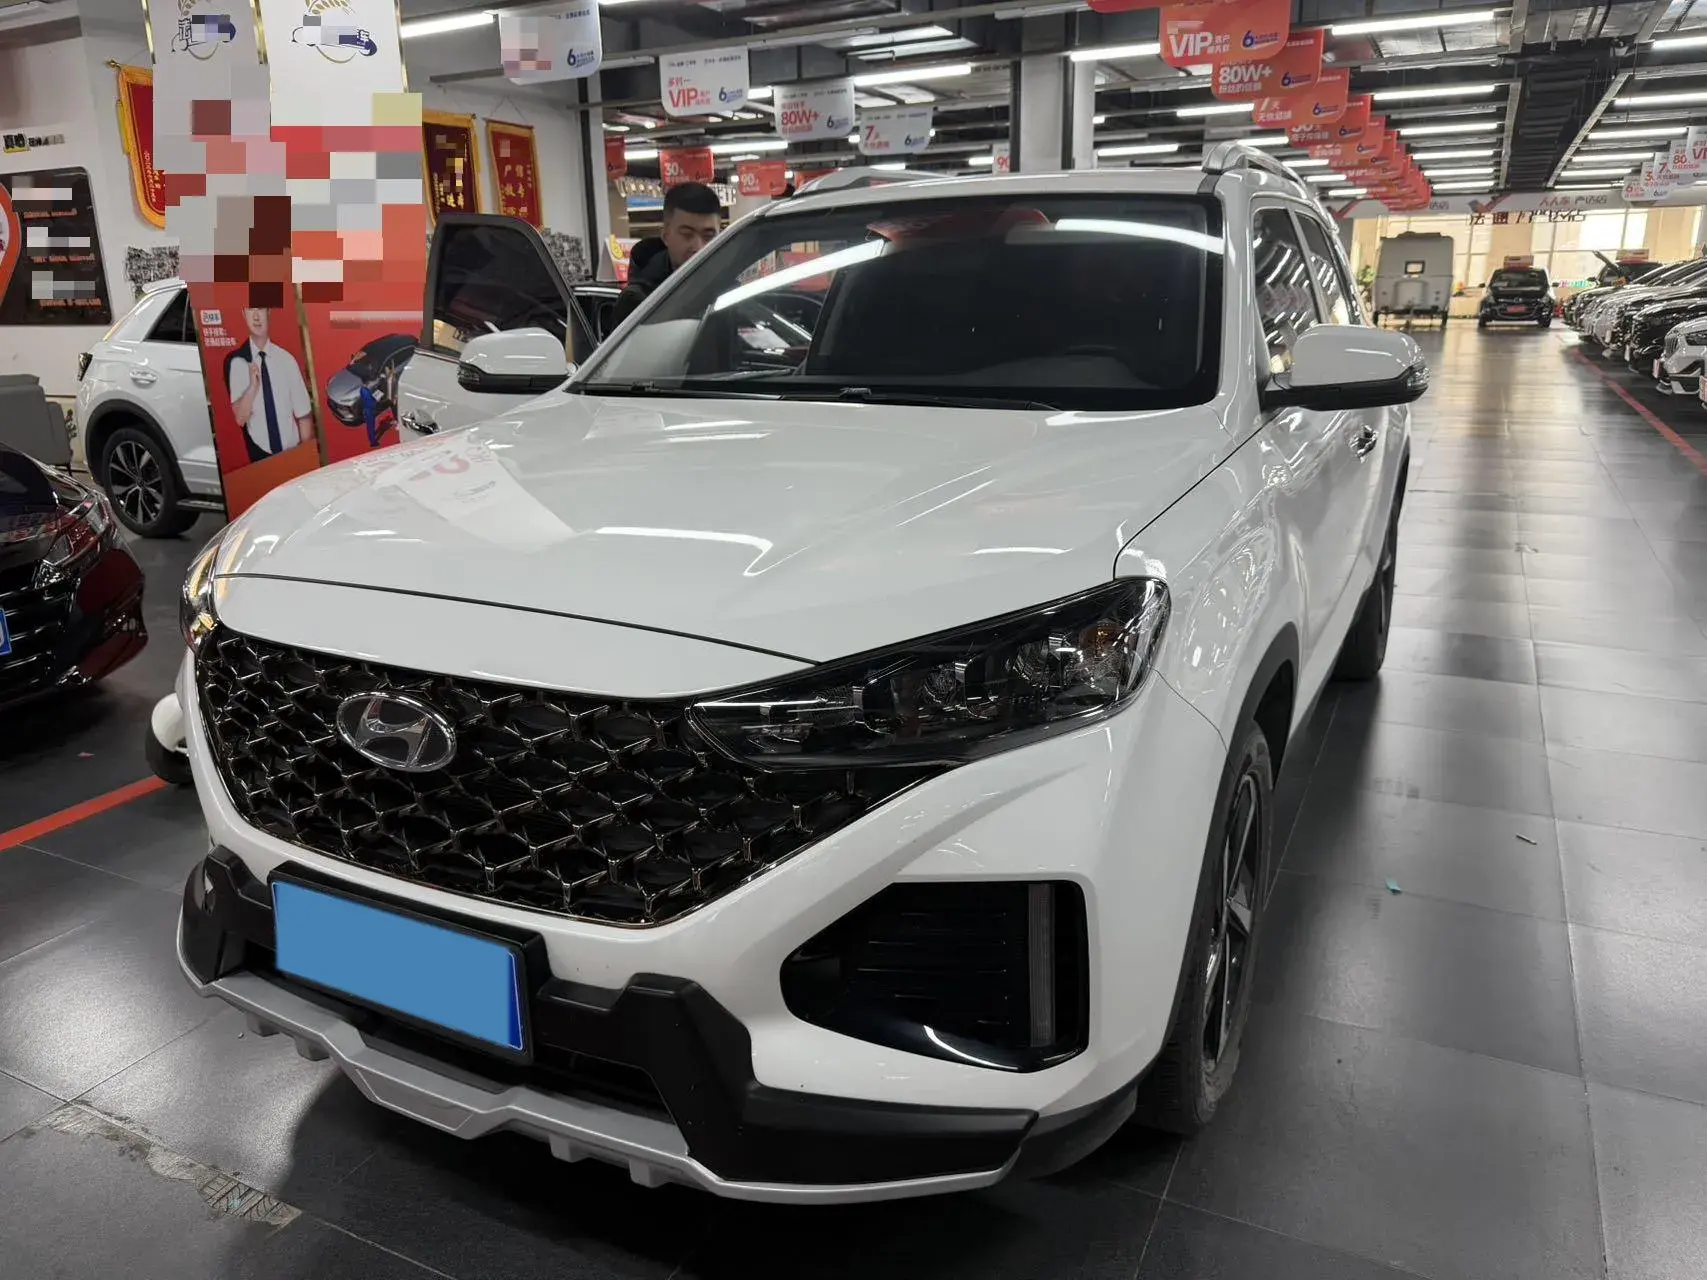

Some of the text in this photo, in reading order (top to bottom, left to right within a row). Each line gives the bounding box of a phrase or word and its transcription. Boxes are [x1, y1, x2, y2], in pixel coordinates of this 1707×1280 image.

[1168, 31, 1214, 58] VIP
[1243, 30, 1254, 48] 6
[567, 48, 576, 66] 6
[1218, 64, 1273, 83] 80W+
[1281, 71, 1292, 86] 6
[668, 87, 698, 108] VIP
[718, 86, 728, 101] 6
[1313, 102, 1322, 116] 6
[781, 109, 821, 127] 80W+
[826, 114, 835, 128] 6
[865, 124, 876, 141] 7
[904, 134, 912, 146] 6
[1673, 155, 1687, 164] 80
[664, 162, 679, 176] 30
[740, 172, 756, 186] 90
